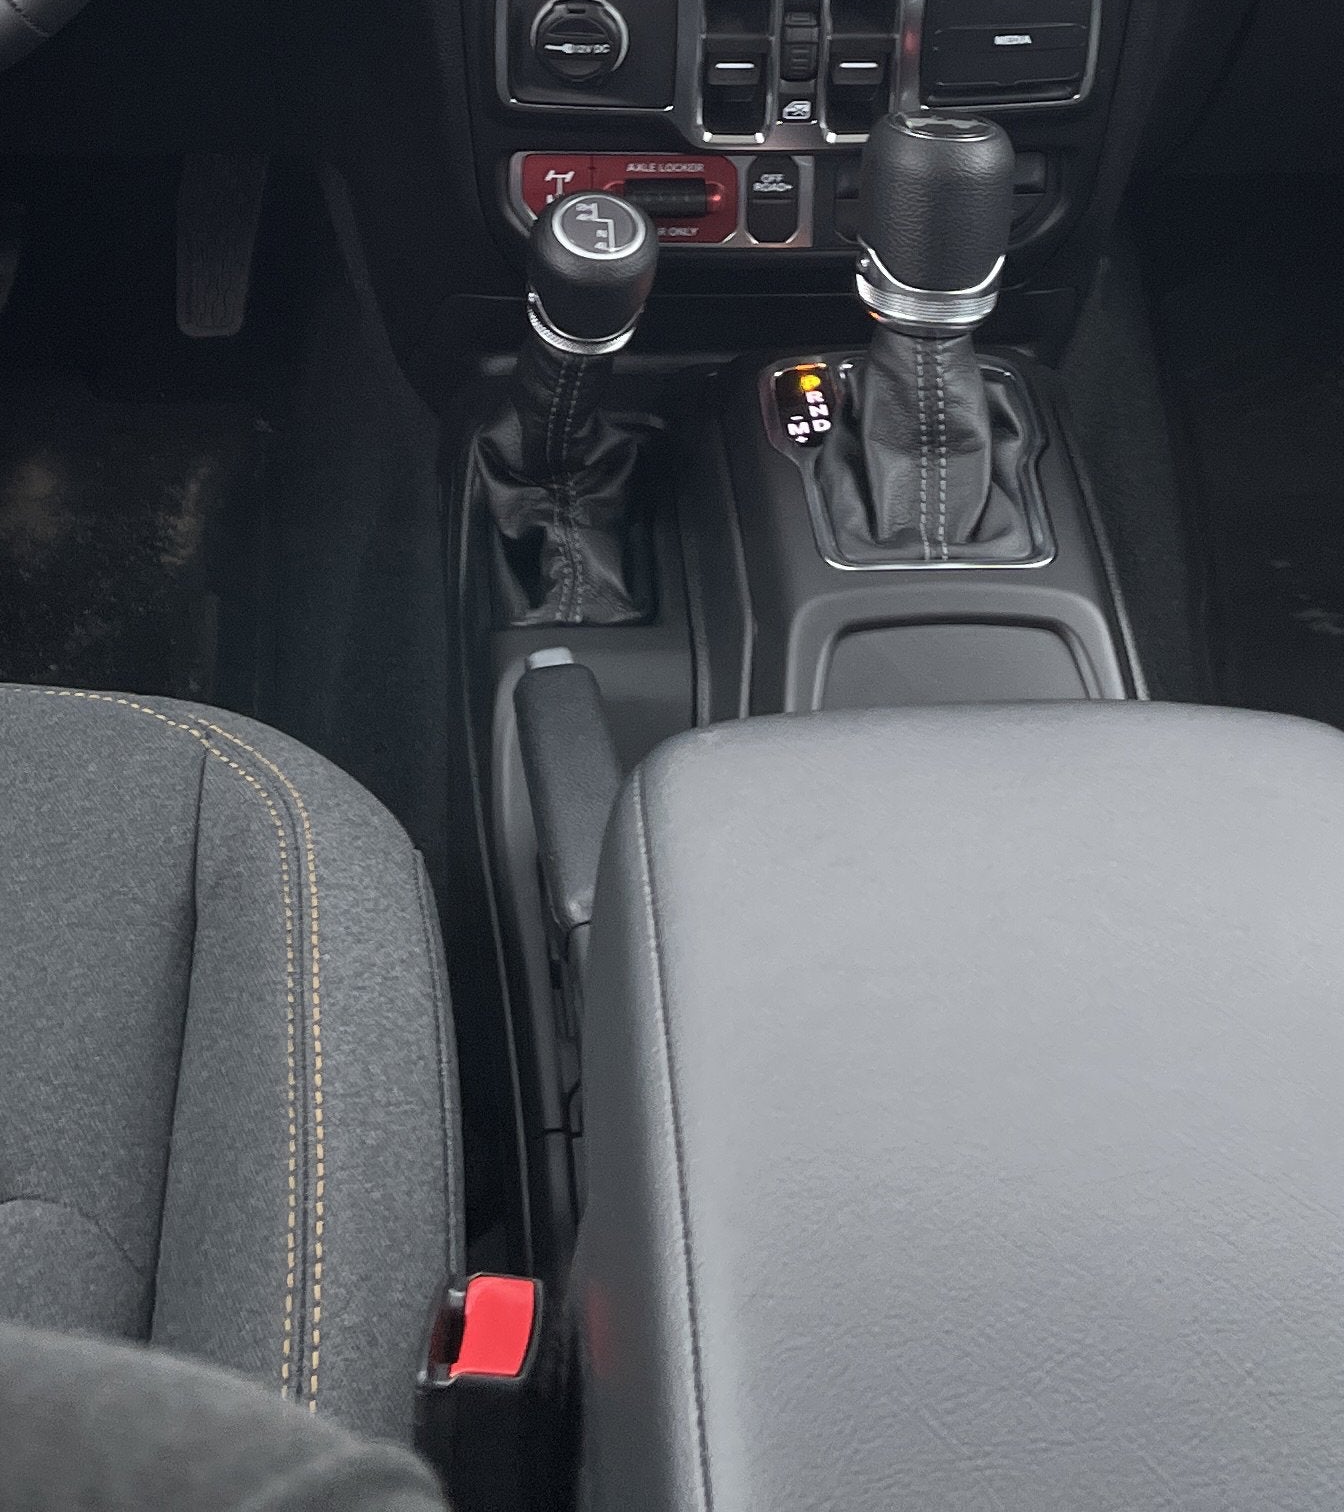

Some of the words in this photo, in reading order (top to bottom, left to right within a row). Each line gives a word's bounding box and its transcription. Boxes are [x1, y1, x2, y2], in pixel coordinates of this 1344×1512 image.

[626, 162, 657, 173] AXLE
[658, 162, 705, 173] LOCKER
[760, 174, 784, 183] OFF
[667, 227, 699, 237] ONLY
[806, 390, 824, 403] R
[809, 404, 829, 417] N
[787, 422, 811, 436] M
[812, 419, 832, 432] D
